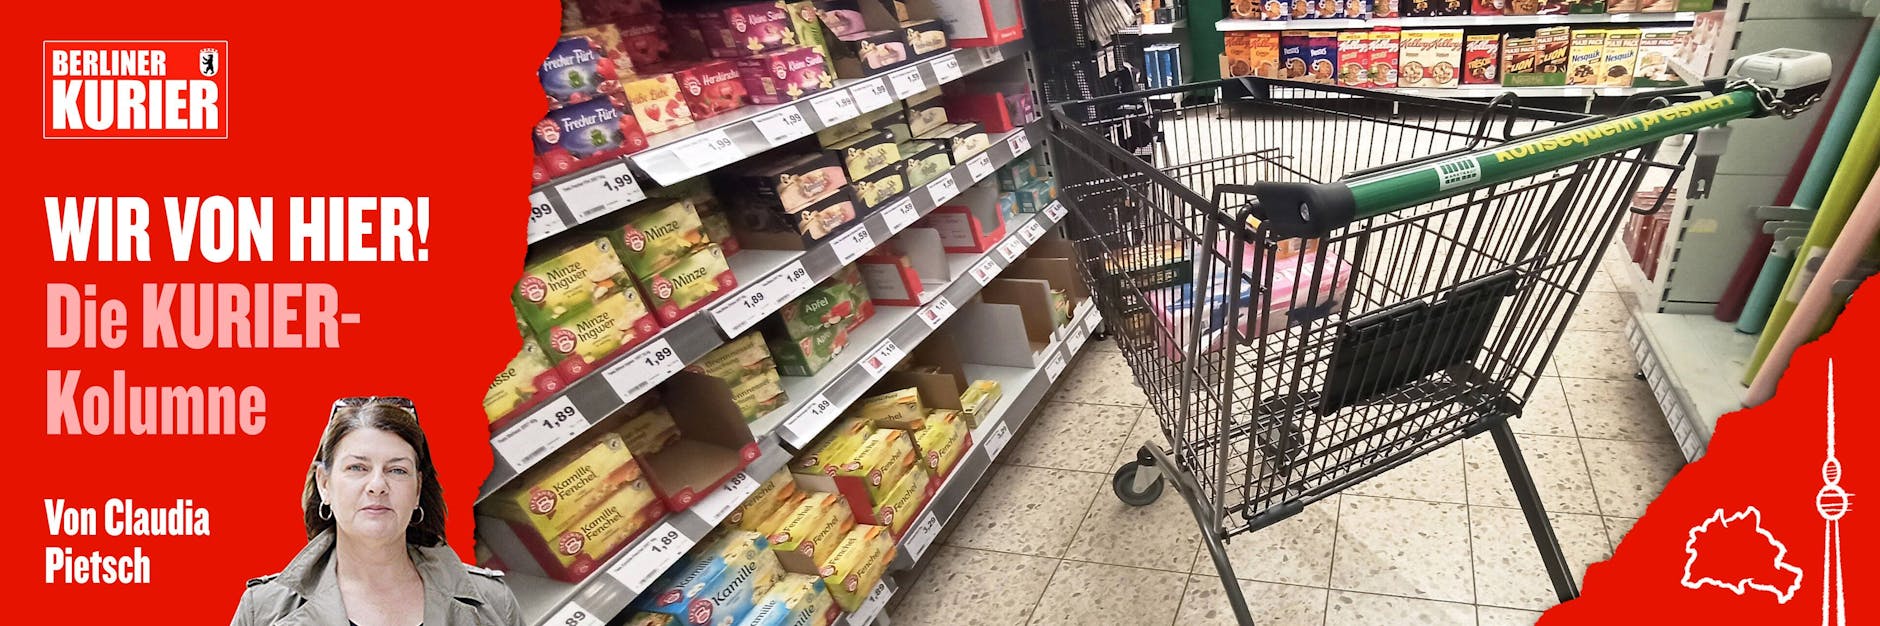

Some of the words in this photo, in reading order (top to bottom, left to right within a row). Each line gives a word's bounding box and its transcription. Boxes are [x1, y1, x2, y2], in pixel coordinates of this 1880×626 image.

[543, 54, 574, 72] Frecher
[573, 48, 595, 65] Flirt
[1510, 57, 1535, 73] LION
[1543, 46, 1568, 63] LION
[1572, 49, 1600, 63] Nesquik
[1605, 49, 1634, 63] Nesquik
[560, 114, 599, 133] Frecher
[594, 106, 619, 124] Flirt
[782, 112, 802, 127] 1,99
[708, 134, 733, 153] 1,99
[1495, 113, 1640, 163] konsequent
[602, 173, 634, 193] 1,99
[530, 202, 553, 223] ,99
[644, 220, 681, 242] Minze
[853, 230, 868, 244] 1,59
[546, 261, 582, 281] Minze
[547, 268, 588, 292] Ingwer
[672, 266, 707, 290] Minze
[786, 267, 805, 284] 1,89
[743, 292, 765, 310] 1,89
[805, 297, 829, 313] Apfel
[576, 311, 610, 333] Minze
[577, 318, 616, 343] Ingwer
[645, 346, 673, 367] 1,89
[489, 367, 517, 390] sse
[542, 405, 576, 430] 1,89
[812, 399, 831, 416] 1,89
[553, 464, 593, 493] Kamille
[558, 470, 599, 500] Fenchel
[724, 472, 747, 493] 1,89
[893, 482, 918, 515] Fenchel
[581, 505, 618, 534] Kamille
[585, 510, 625, 541] Fenchel
[783, 504, 814, 534] Fenchel
[813, 515, 839, 546] Fenchel
[922, 516, 937, 535] 3,29
[651, 530, 679, 554] 1,89
[828, 536, 857, 567] Fenchel
[676, 555, 715, 589] Kamille
[857, 547, 881, 579] Fenchel
[711, 560, 757, 607] Kamille
[868, 583, 886, 603] 1,89
[750, 599, 776, 626] amille
